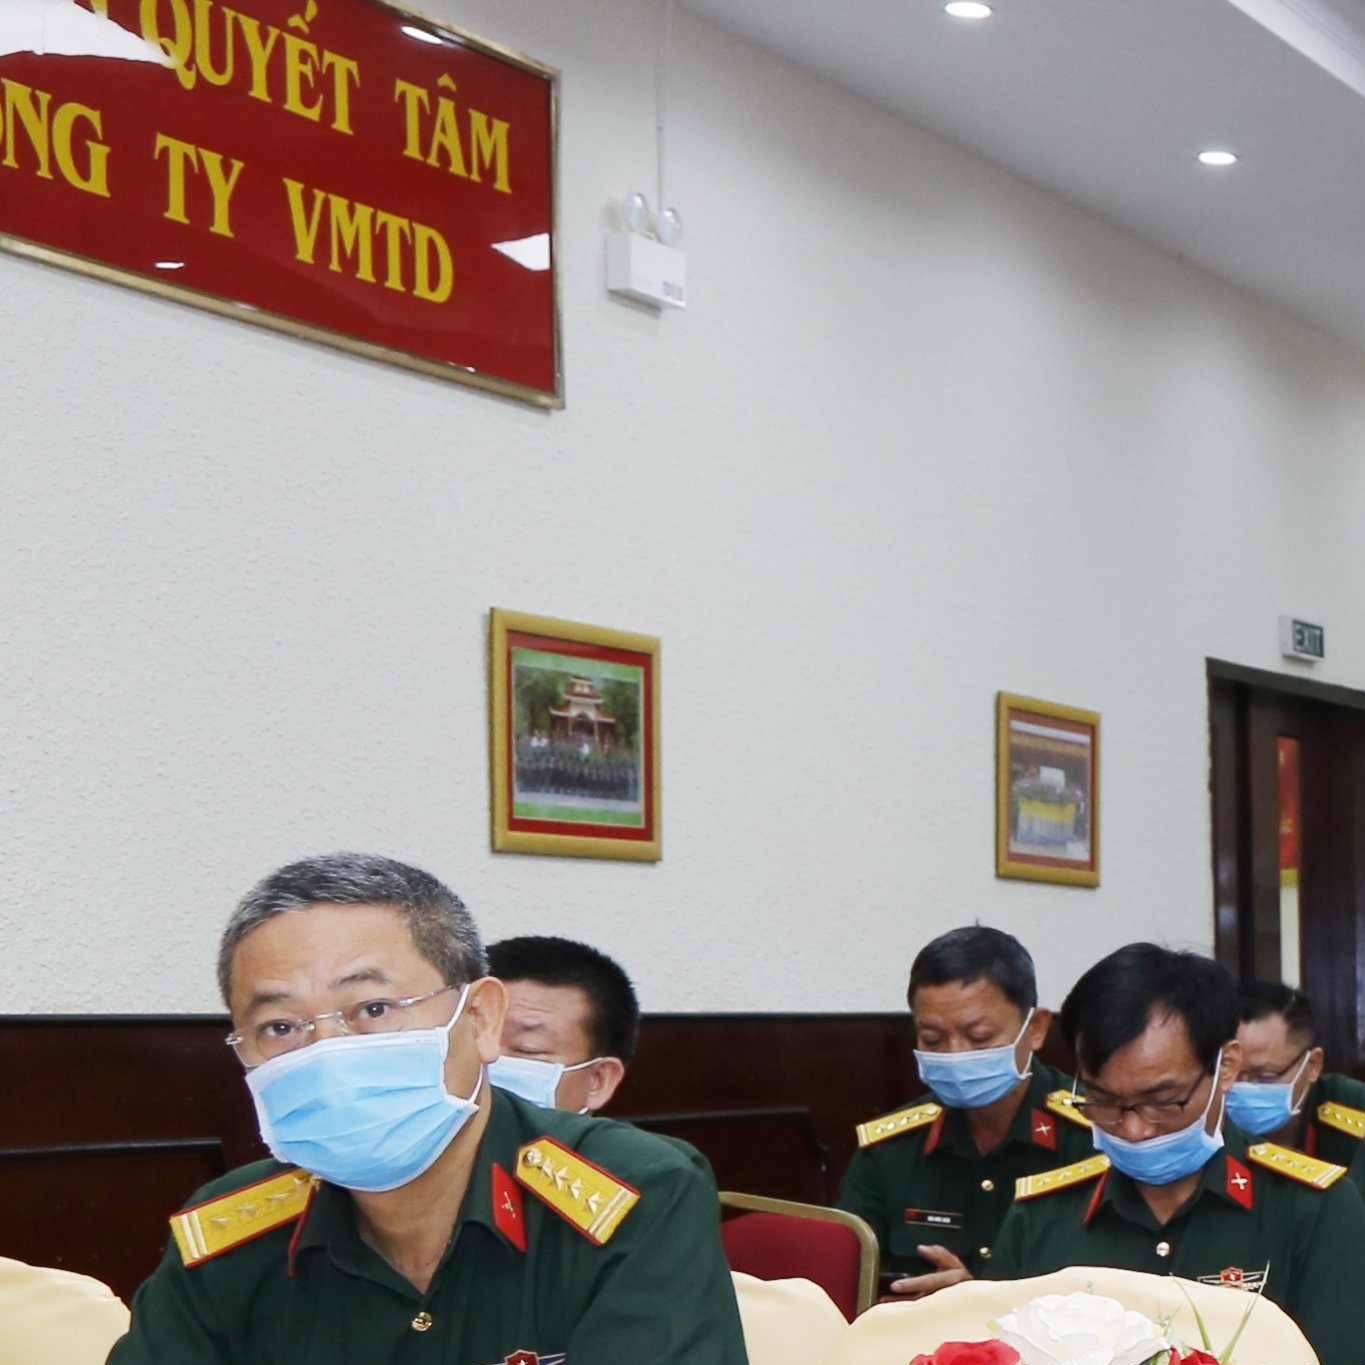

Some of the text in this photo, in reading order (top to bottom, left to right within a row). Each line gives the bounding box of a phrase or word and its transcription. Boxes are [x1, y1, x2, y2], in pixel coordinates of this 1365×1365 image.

[0, 77, 454, 302] NG TY VMTD
[139, 0, 511, 194] QUYẾT TÂM
